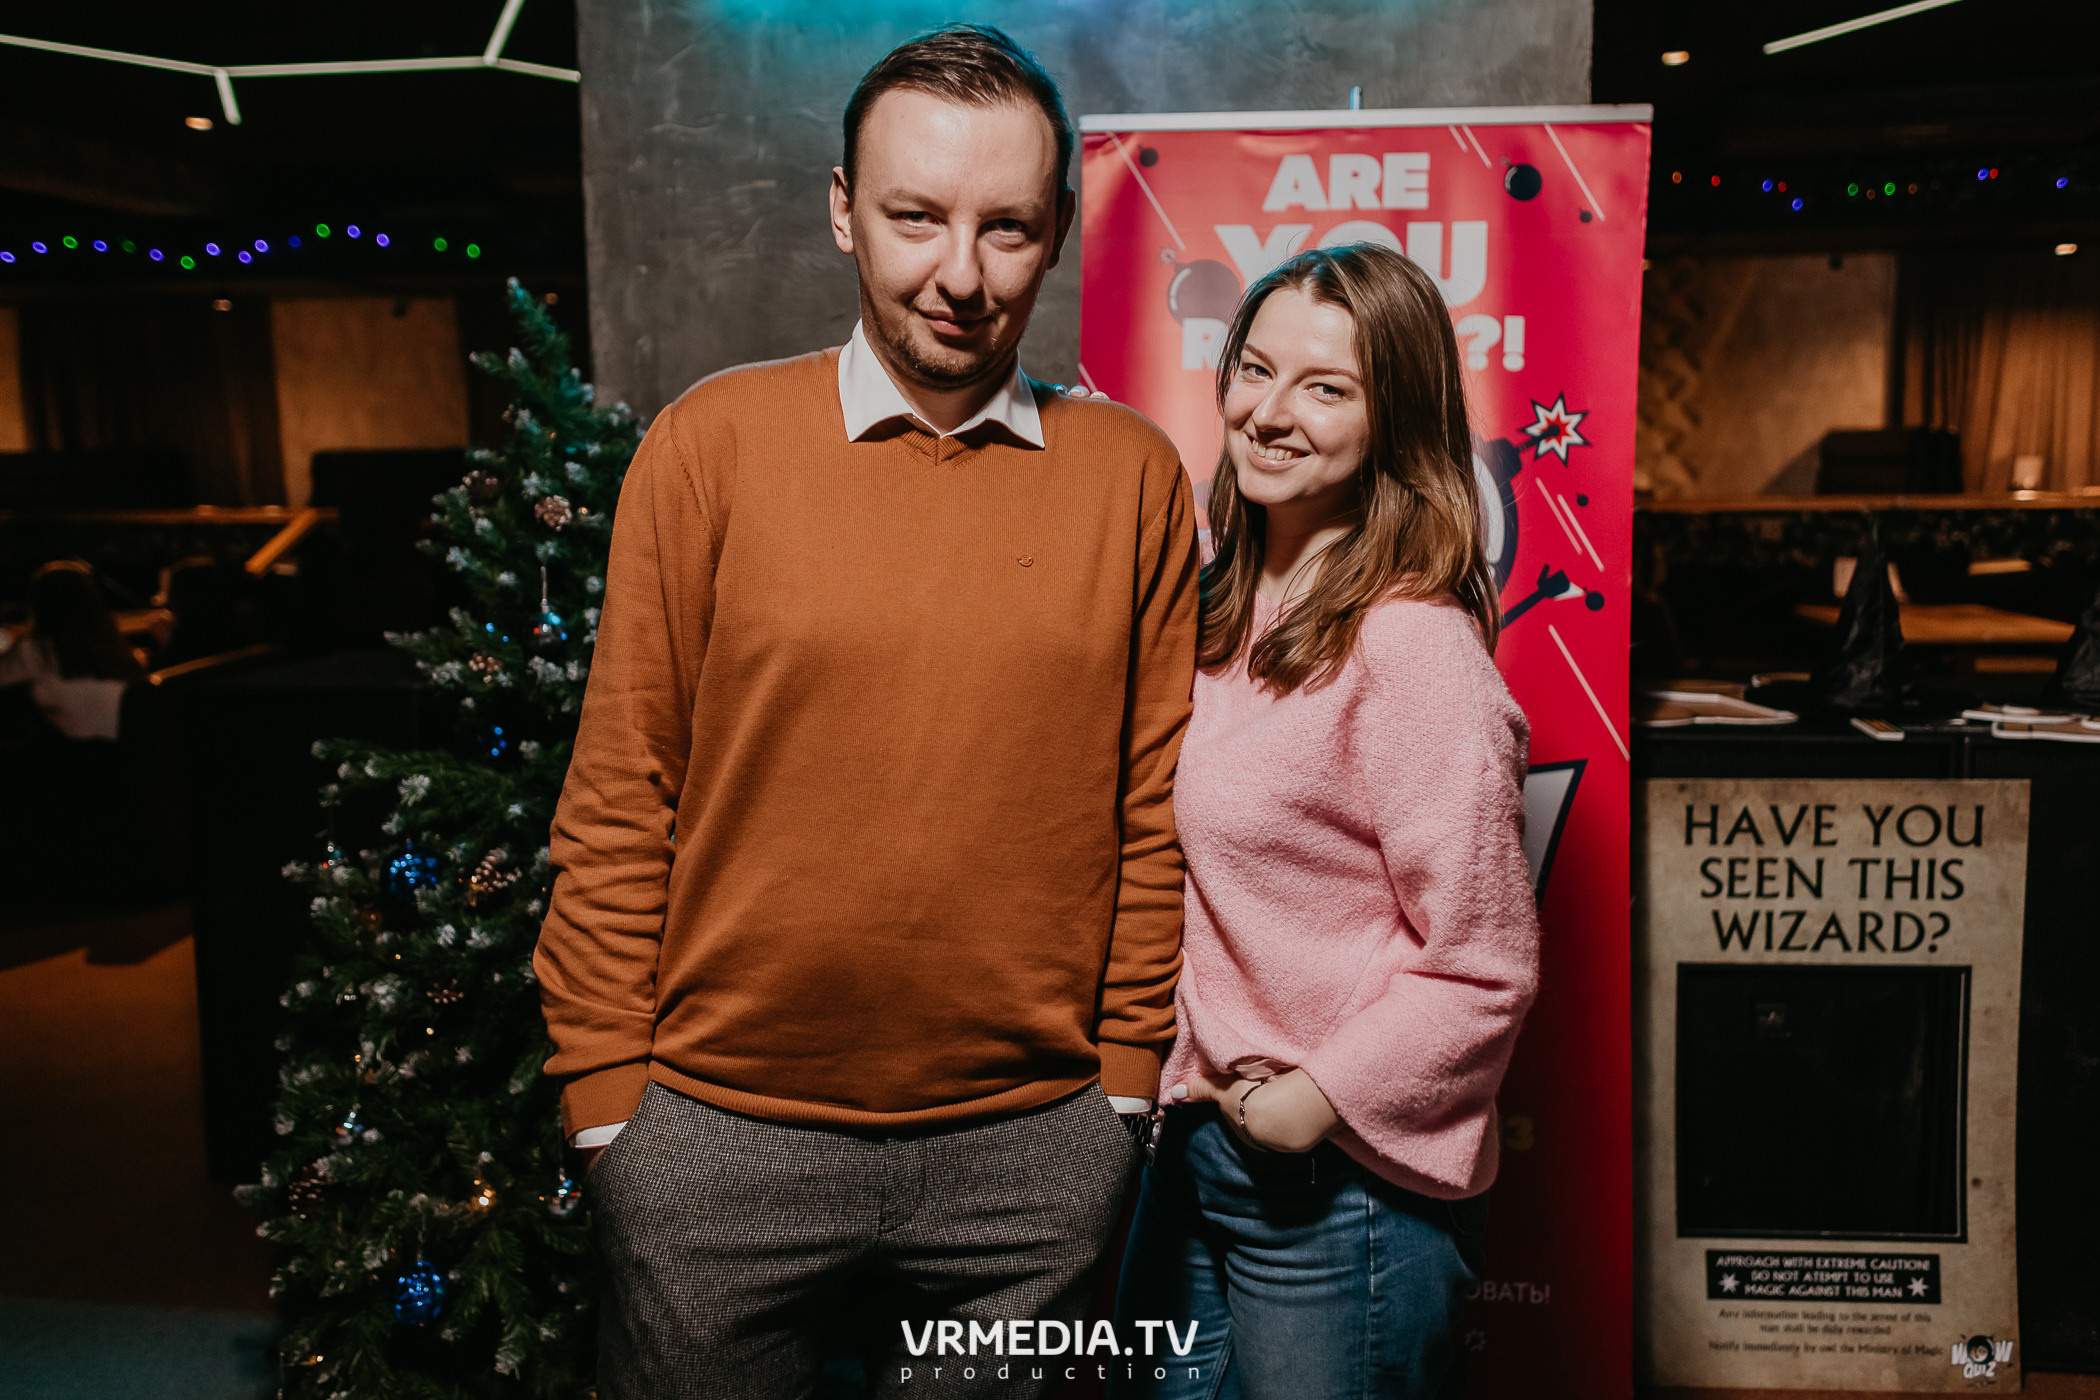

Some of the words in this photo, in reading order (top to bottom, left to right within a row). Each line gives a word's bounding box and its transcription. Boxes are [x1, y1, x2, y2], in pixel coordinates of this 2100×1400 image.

[1262, 152, 1430, 212] ARE
[1213, 220, 1488, 308] YU
[1684, 804, 1838, 847] HAVE
[1863, 804, 1985, 847] YOU
[1700, 857, 1825, 900] SEEN
[1847, 857, 1965, 901] THIS
[1712, 910, 1951, 953] WIZARD?
[1716, 1255, 1781, 1268] APPROACH
[1782, 1256, 1814, 1268] WITH
[1815, 1257, 1867, 1270] EXTREME
[1751, 1270, 1771, 1282] DO
[1772, 1270, 1799, 1282] NOT
[1853, 1272, 1871, 1284] TO
[1873, 1272, 1894, 1285] USE
[1744, 1284, 1786, 1296] MAGIC
[1788, 1284, 1840, 1297] AGAINST
[1845, 1285, 1870, 1298] THIS
[1872, 1286, 1903, 1298] MAN
[1963, 1360, 1997, 1379] QUIZ
